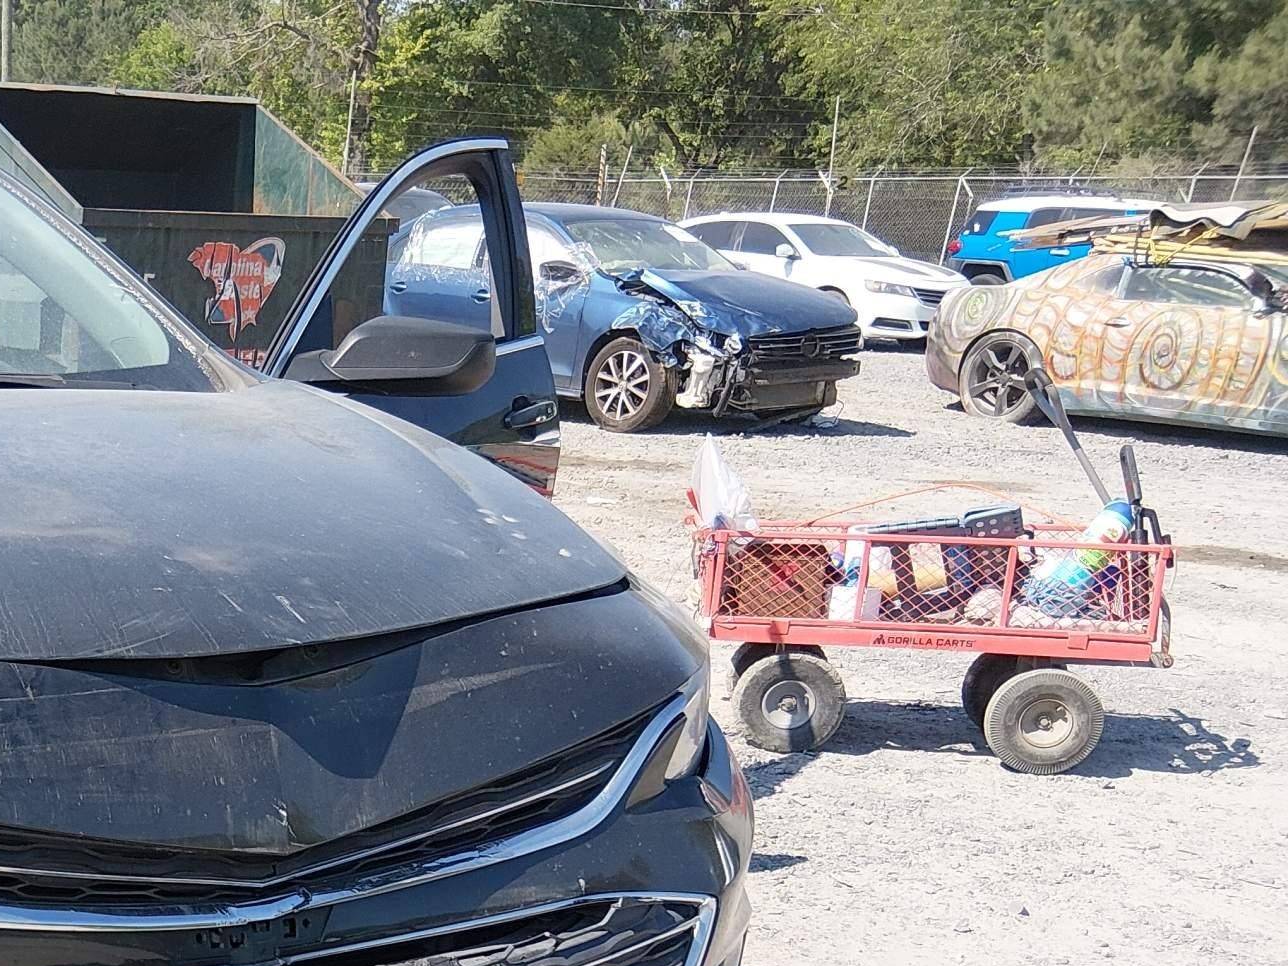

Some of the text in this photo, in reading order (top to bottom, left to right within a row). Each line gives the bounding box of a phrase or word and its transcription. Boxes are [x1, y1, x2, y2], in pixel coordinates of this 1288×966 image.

[836, 176, 848, 190] 2
[887, 636, 974, 648] GORILLA CARTS
